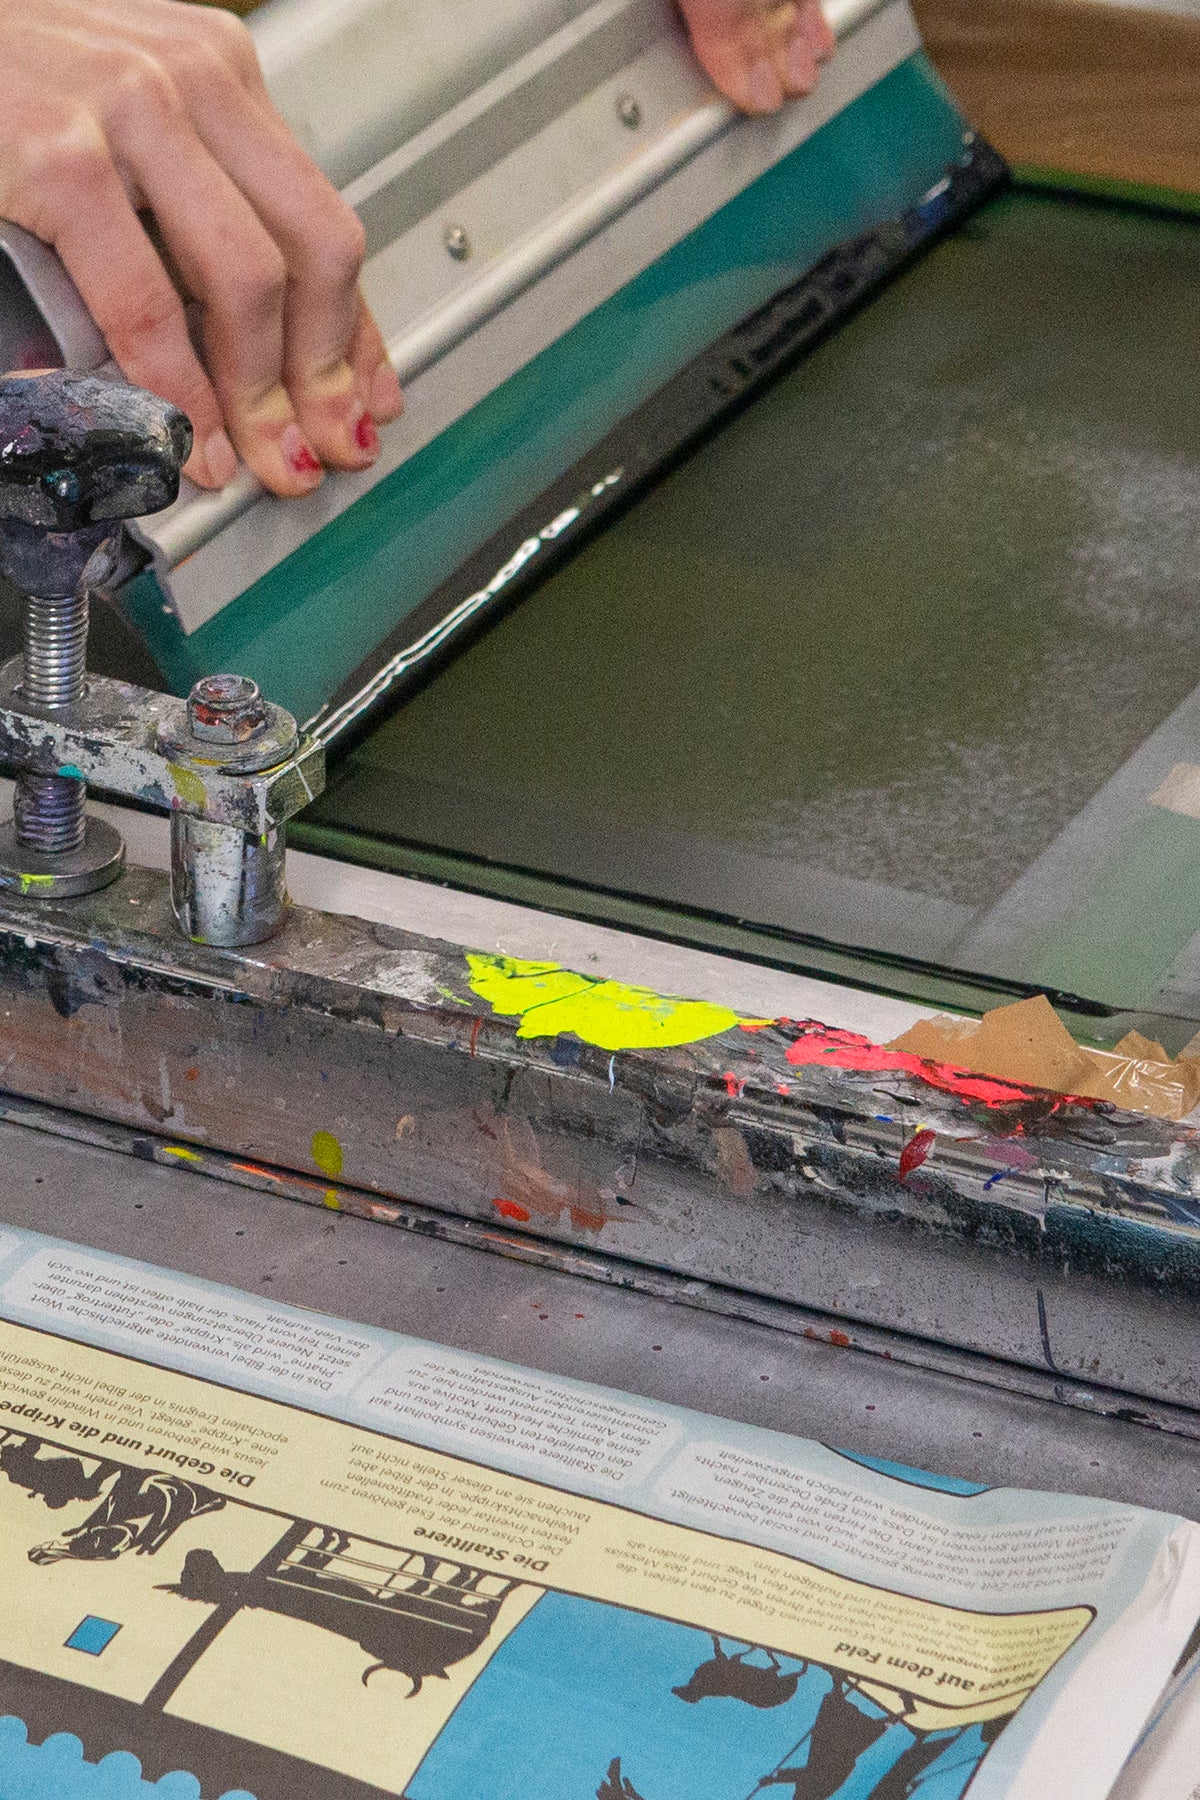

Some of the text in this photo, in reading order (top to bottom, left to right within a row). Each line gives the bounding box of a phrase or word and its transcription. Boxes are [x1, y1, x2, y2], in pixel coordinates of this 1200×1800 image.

[28, 1293, 333, 1390] Das in der Bibel verwendete altgriechische Wort
[58, 1369, 94, 1384] nicht
[93, 1380, 128, 1396] Bibel
[129, 1390, 152, 1404] der
[46, 1395, 102, 1418] Windeln
[152, 1397, 167, 1408] in
[102, 1412, 117, 1423] in
[167, 1402, 219, 1424] Ereignis
[66, 1421, 101, 1441] die
[116, 1417, 145, 1429] und
[220, 1418, 289, 1443] epochalen
[99, 1432, 142, 1450] und
[145, 1425, 201, 1446] geboren
[366, 1395, 625, 1480] Die Stalltiere verweisen symbolhaft auf
[198, 1442, 231, 1455] wird
[142, 1445, 217, 1475] Geburt
[232, 1451, 269, 1469] Jesus
[374, 1451, 410, 1466] nicht
[218, 1467, 256, 1487] Die
[410, 1462, 450, 1480] Stelle
[451, 1474, 494, 1494] dieser
[494, 1487, 513, 1497] an
[514, 1493, 535, 1504] sie
[536, 1500, 592, 1523] tauchen
[412, 1526, 549, 1571] Die Stalltiere
[831, 1641, 976, 1689] auf dem Feld
